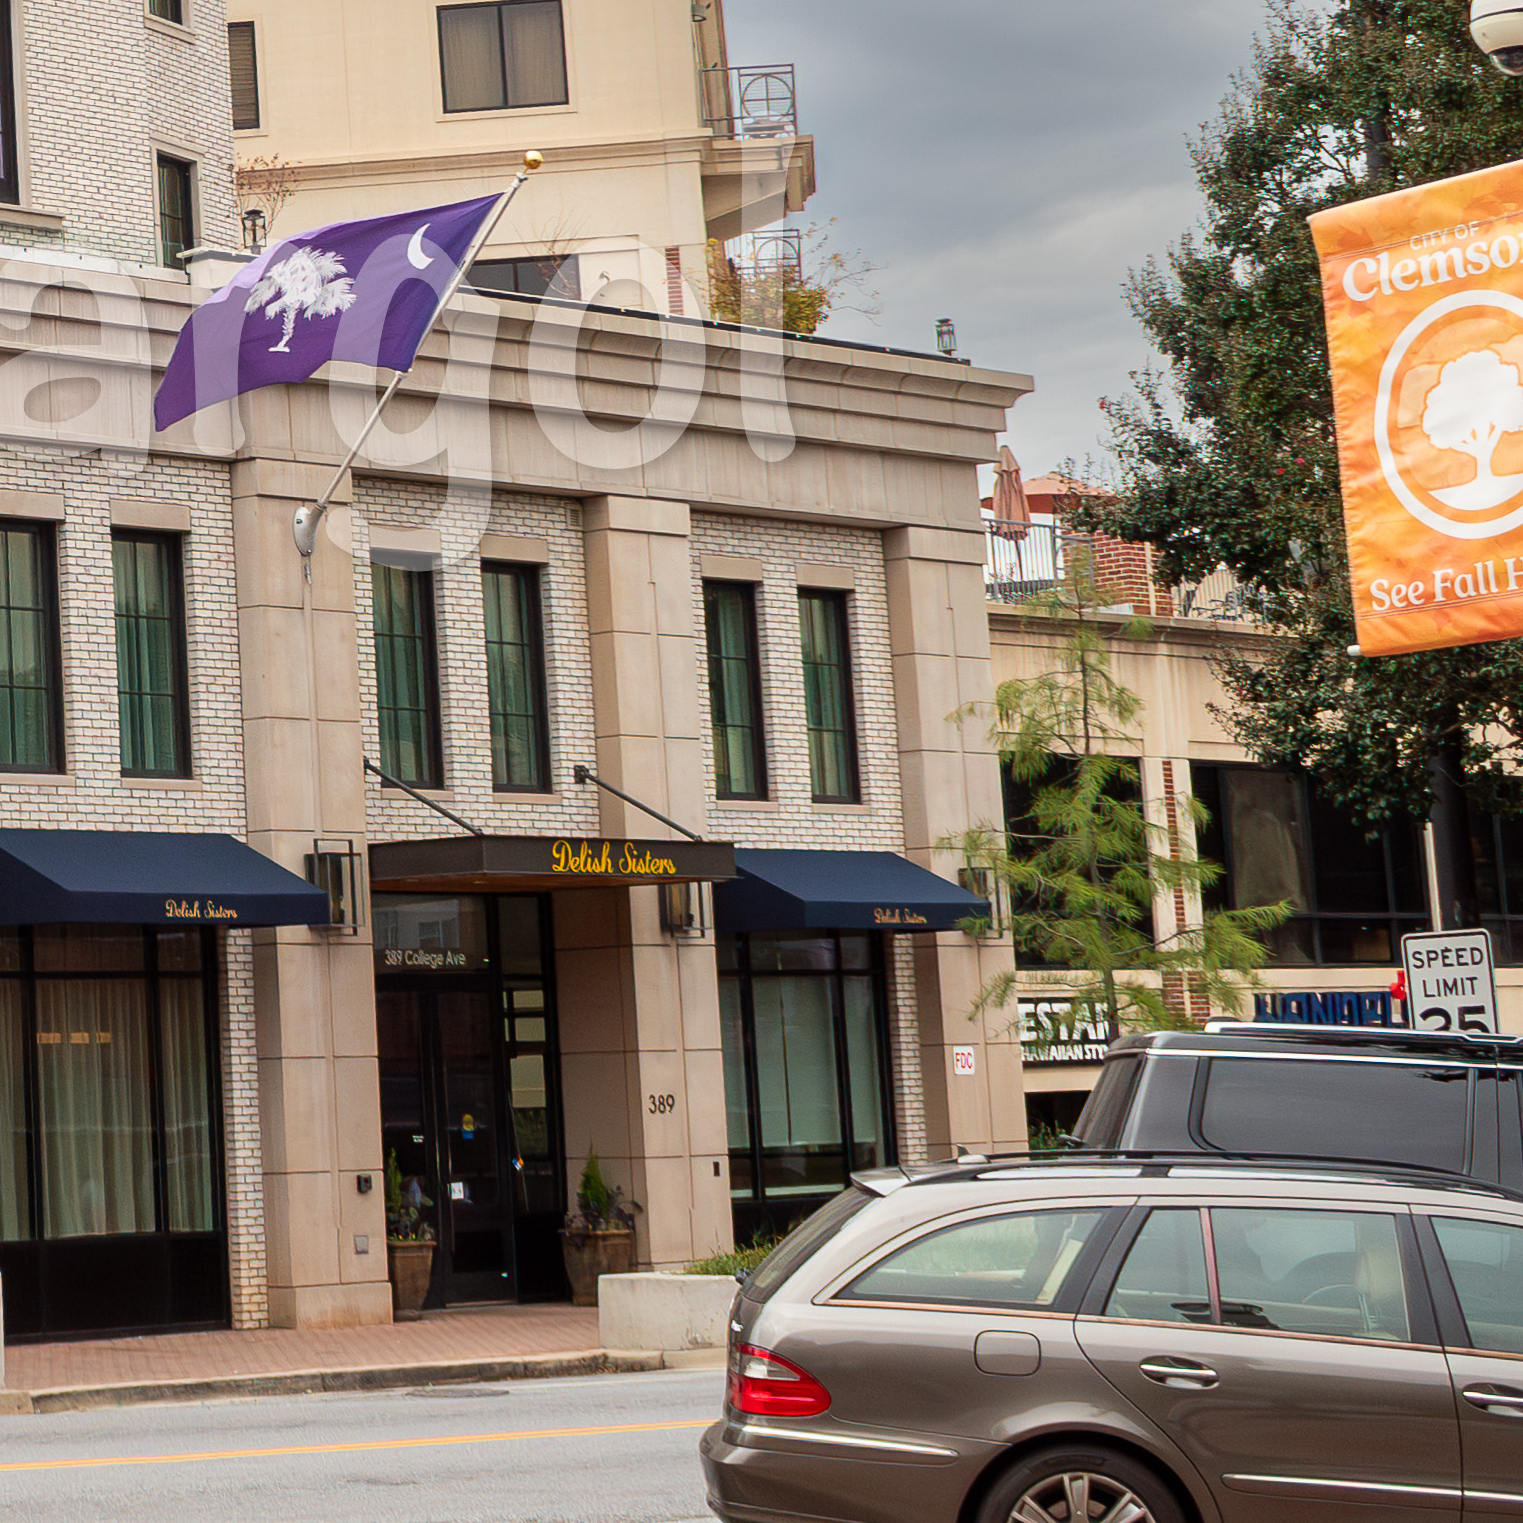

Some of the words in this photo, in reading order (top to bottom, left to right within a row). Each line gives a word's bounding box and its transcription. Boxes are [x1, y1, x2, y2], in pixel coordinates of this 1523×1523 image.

[1410, 228, 1449, 251] CITY
[1454, 221, 1480, 240] OF
[1370, 578, 1425, 611] See
[1433, 559, 1499, 602] Fall
[552, 840, 613, 874] Delish
[619, 842, 677, 875] Sisters
[165, 899, 201, 919] Delish
[204, 900, 238, 919] Sisters
[405, 949, 444, 969] College
[446, 950, 467, 966] Ave
[1412, 947, 1484, 969] SPEED
[1422, 977, 1478, 997] LIMIT
[1419, 1005, 1490, 1034] 25
[955, 1051, 973, 1069] FDC
[1020, 1044, 1083, 1061] HAWAIIAN
[648, 1094, 675, 1114] 389
